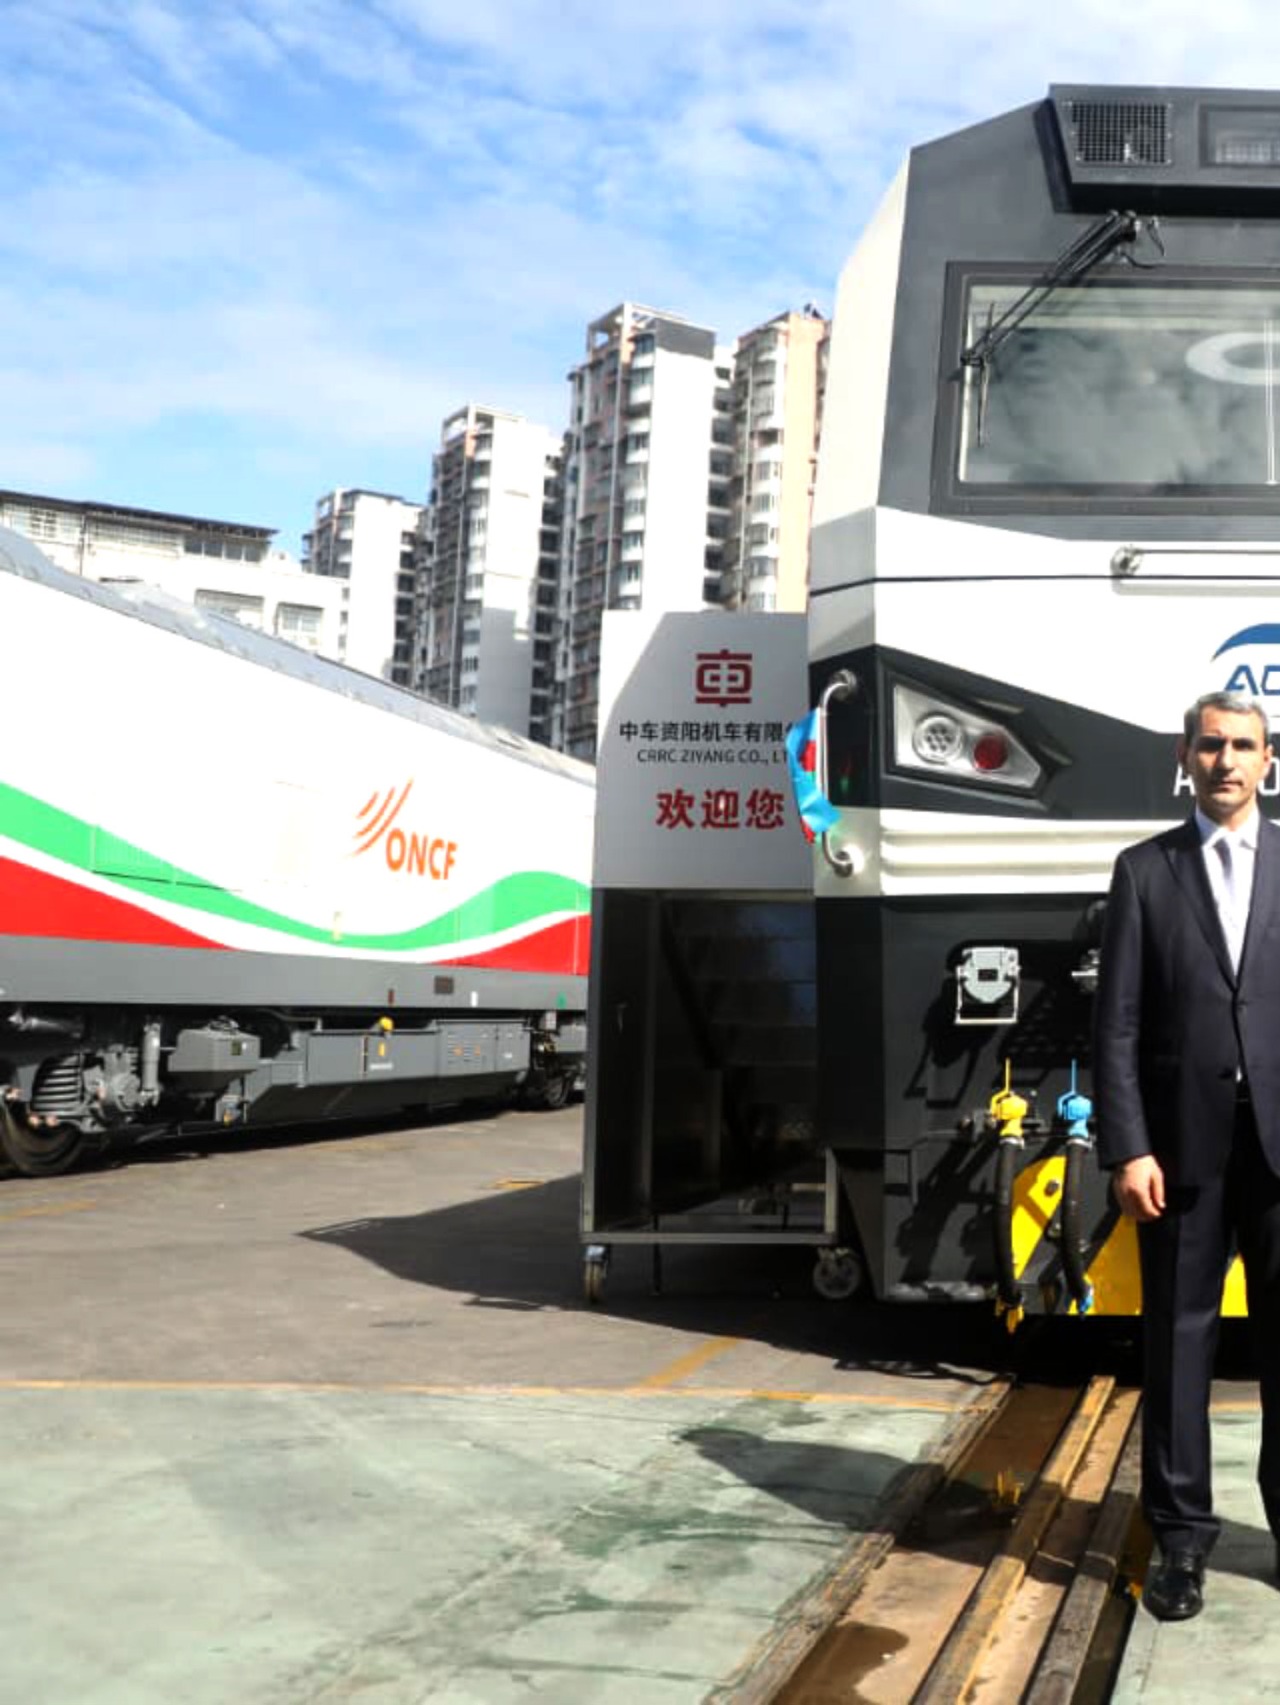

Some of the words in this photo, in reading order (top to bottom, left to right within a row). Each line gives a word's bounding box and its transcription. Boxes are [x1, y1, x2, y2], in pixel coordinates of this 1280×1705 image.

[619, 720, 793, 743] 中车资阳机车有限
[637, 748, 677, 764] CRRC
[680, 748, 735, 764] ZIYANG
[655, 788, 785, 830] 欢迎您
[385, 827, 458, 881] ONCF
